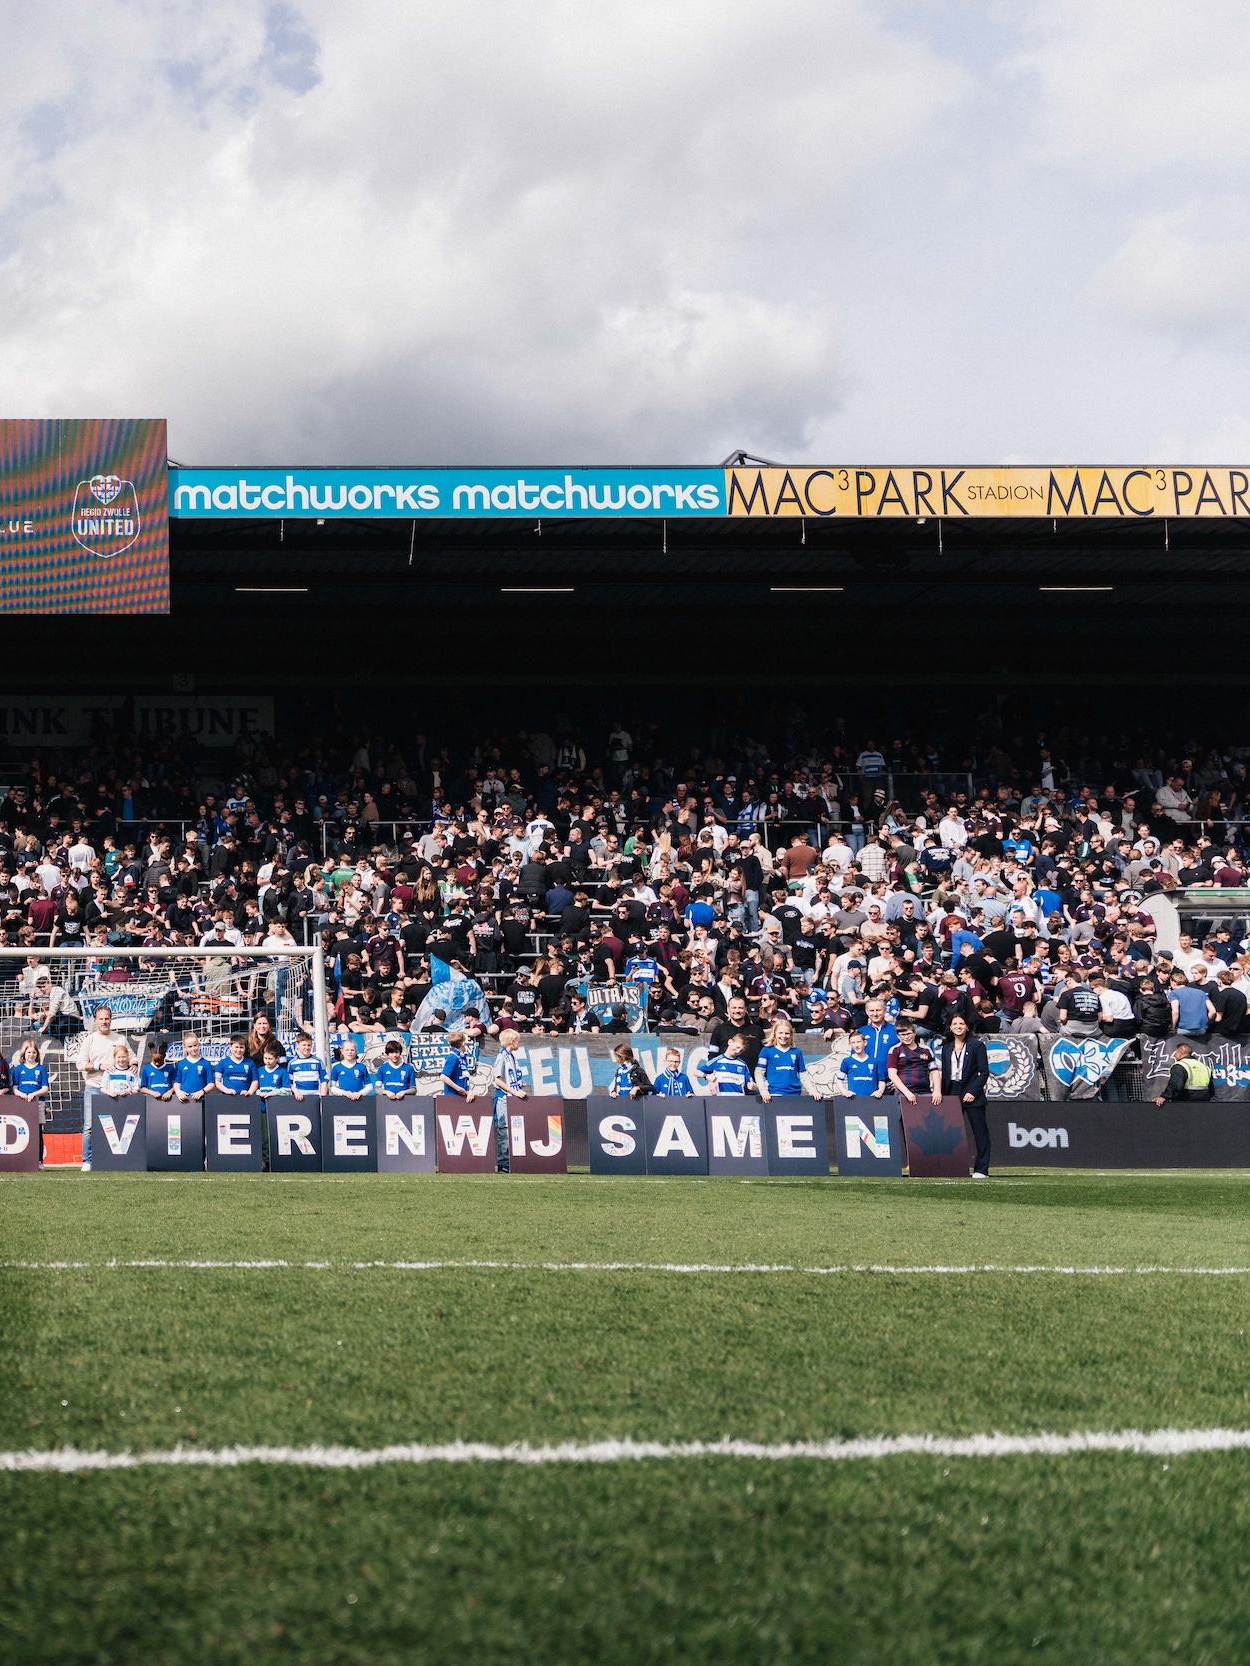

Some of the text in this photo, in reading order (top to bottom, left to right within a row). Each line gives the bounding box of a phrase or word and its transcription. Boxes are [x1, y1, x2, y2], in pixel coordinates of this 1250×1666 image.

[174, 474, 720, 510] matchworks matchworks
[967, 485, 1045, 500] STADION
[80, 507, 130, 517] REGIO ZWOLLE
[77, 519, 134, 536] UNITED
[179, 674, 188, 687] 3
[588, 987, 638, 1006] ULTRAS
[1013, 982, 1026, 998] 9
[599, 1115, 891, 1158] SAMEN
[1007, 1122, 1070, 1149] bon
